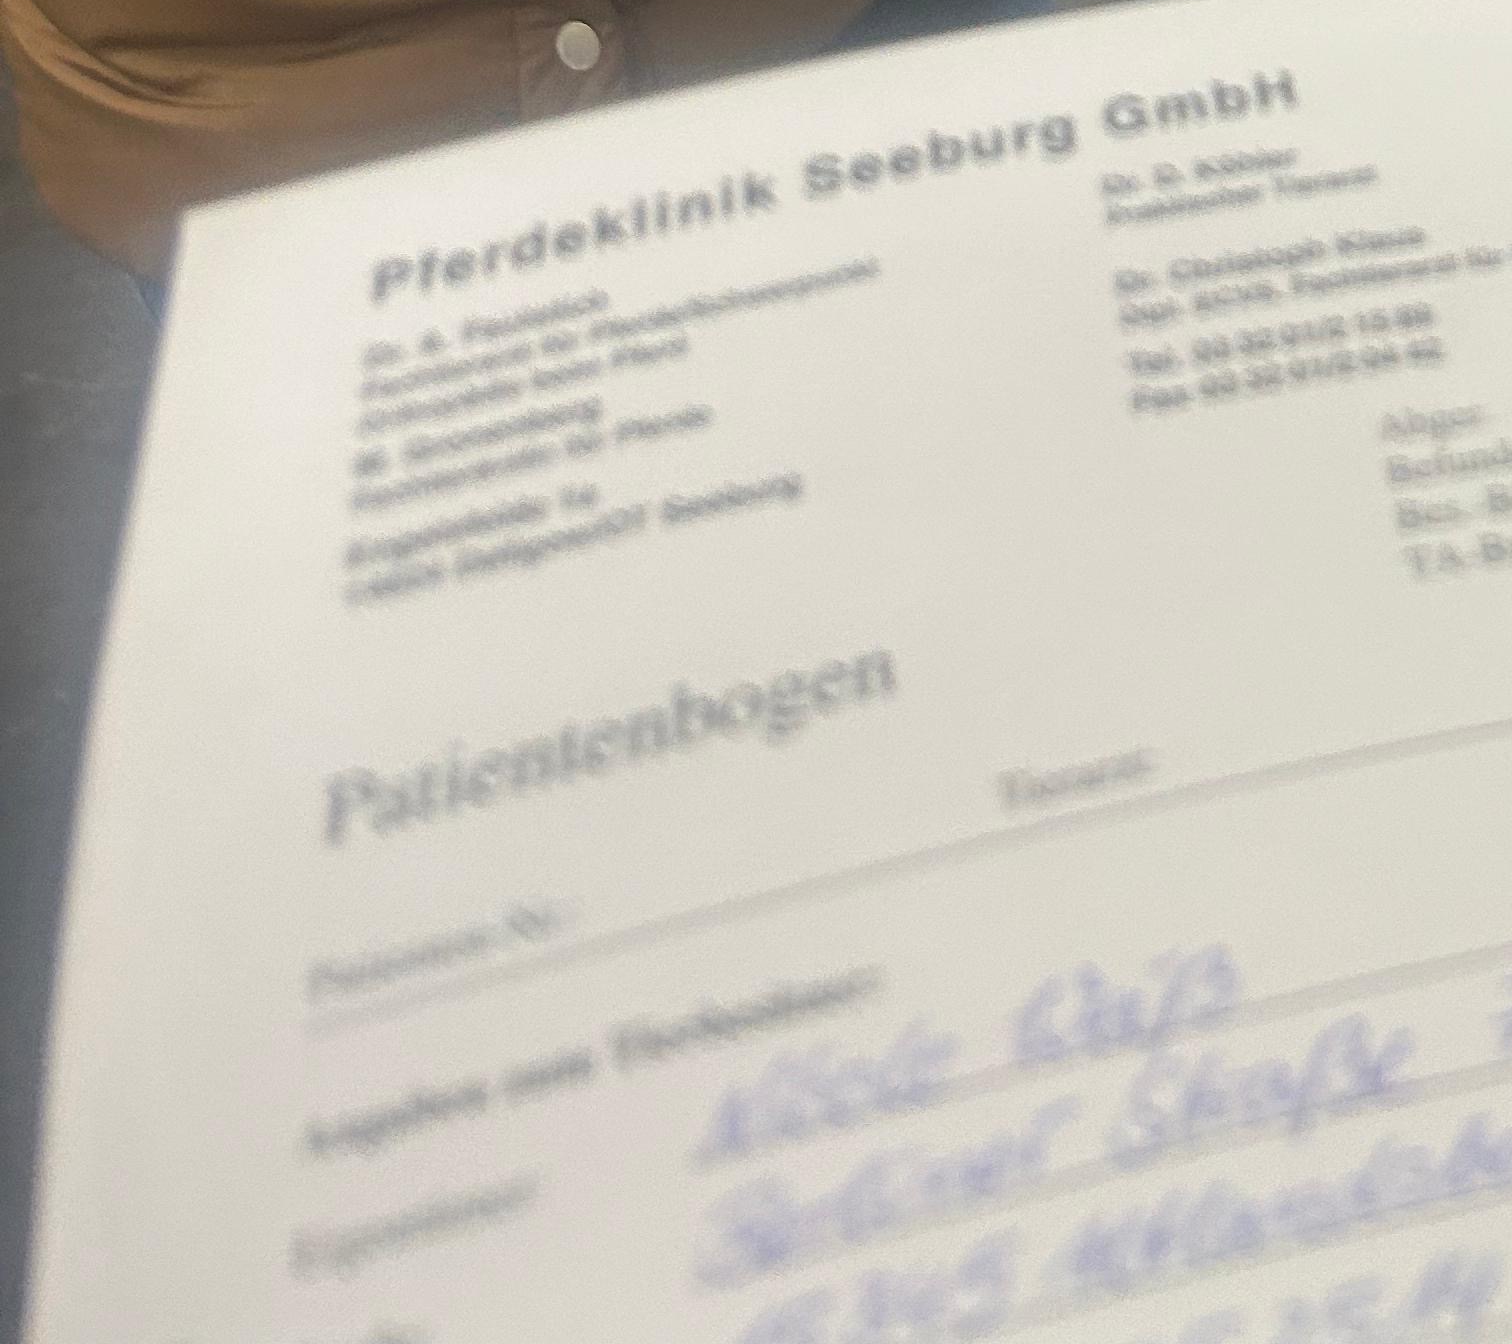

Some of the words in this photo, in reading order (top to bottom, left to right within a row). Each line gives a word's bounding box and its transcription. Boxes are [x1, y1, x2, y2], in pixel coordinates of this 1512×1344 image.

[370, 173, 778, 302] Pferdeklinik
[802, 113, 1078, 200] Seeburg
[1102, 67, 1299, 139] GmbH
[324, 644, 898, 846] Patientenbogen
